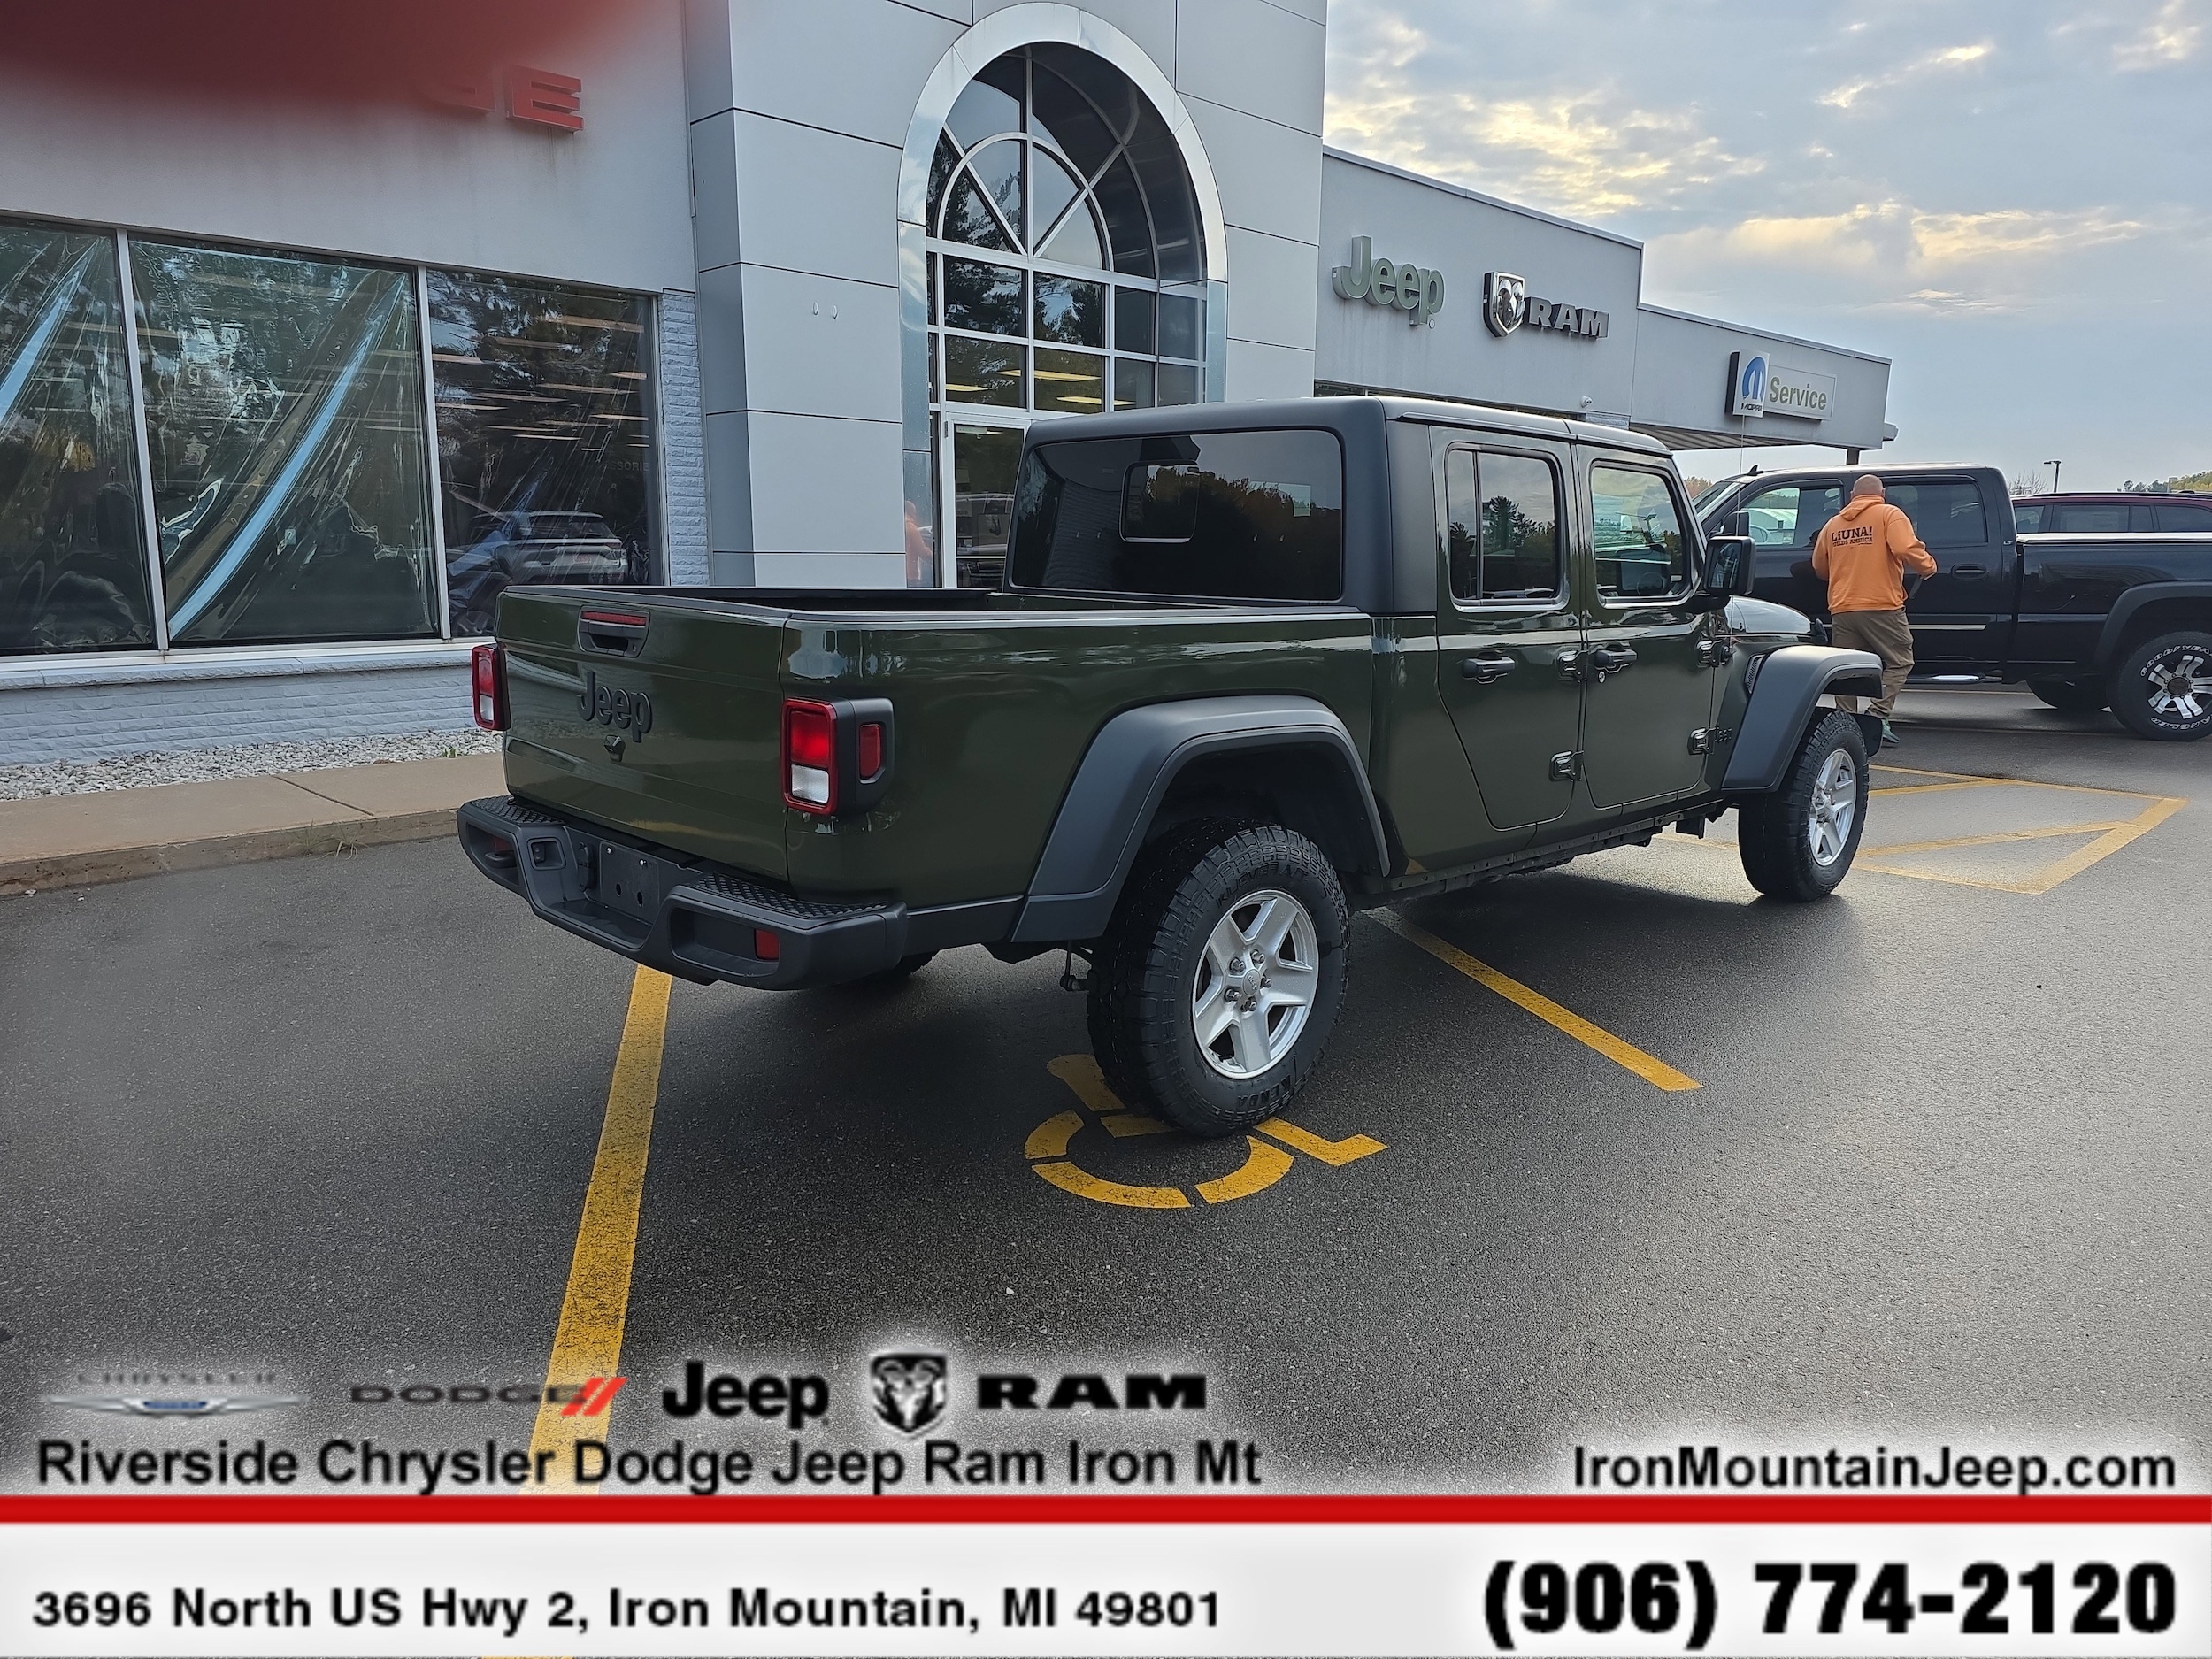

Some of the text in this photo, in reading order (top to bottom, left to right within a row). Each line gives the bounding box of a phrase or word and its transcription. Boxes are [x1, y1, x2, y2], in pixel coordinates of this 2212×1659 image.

[1332, 235, 1445, 327] Jeep
[1522, 296, 1610, 340] RAM
[1769, 376, 1827, 411] Service
[1831, 526, 1873, 542] LiUNA!
[2139, 644, 2212, 677] GOODYEA
[576, 670, 653, 743] Jeep
[2150, 713, 2212, 731] ANGLER
